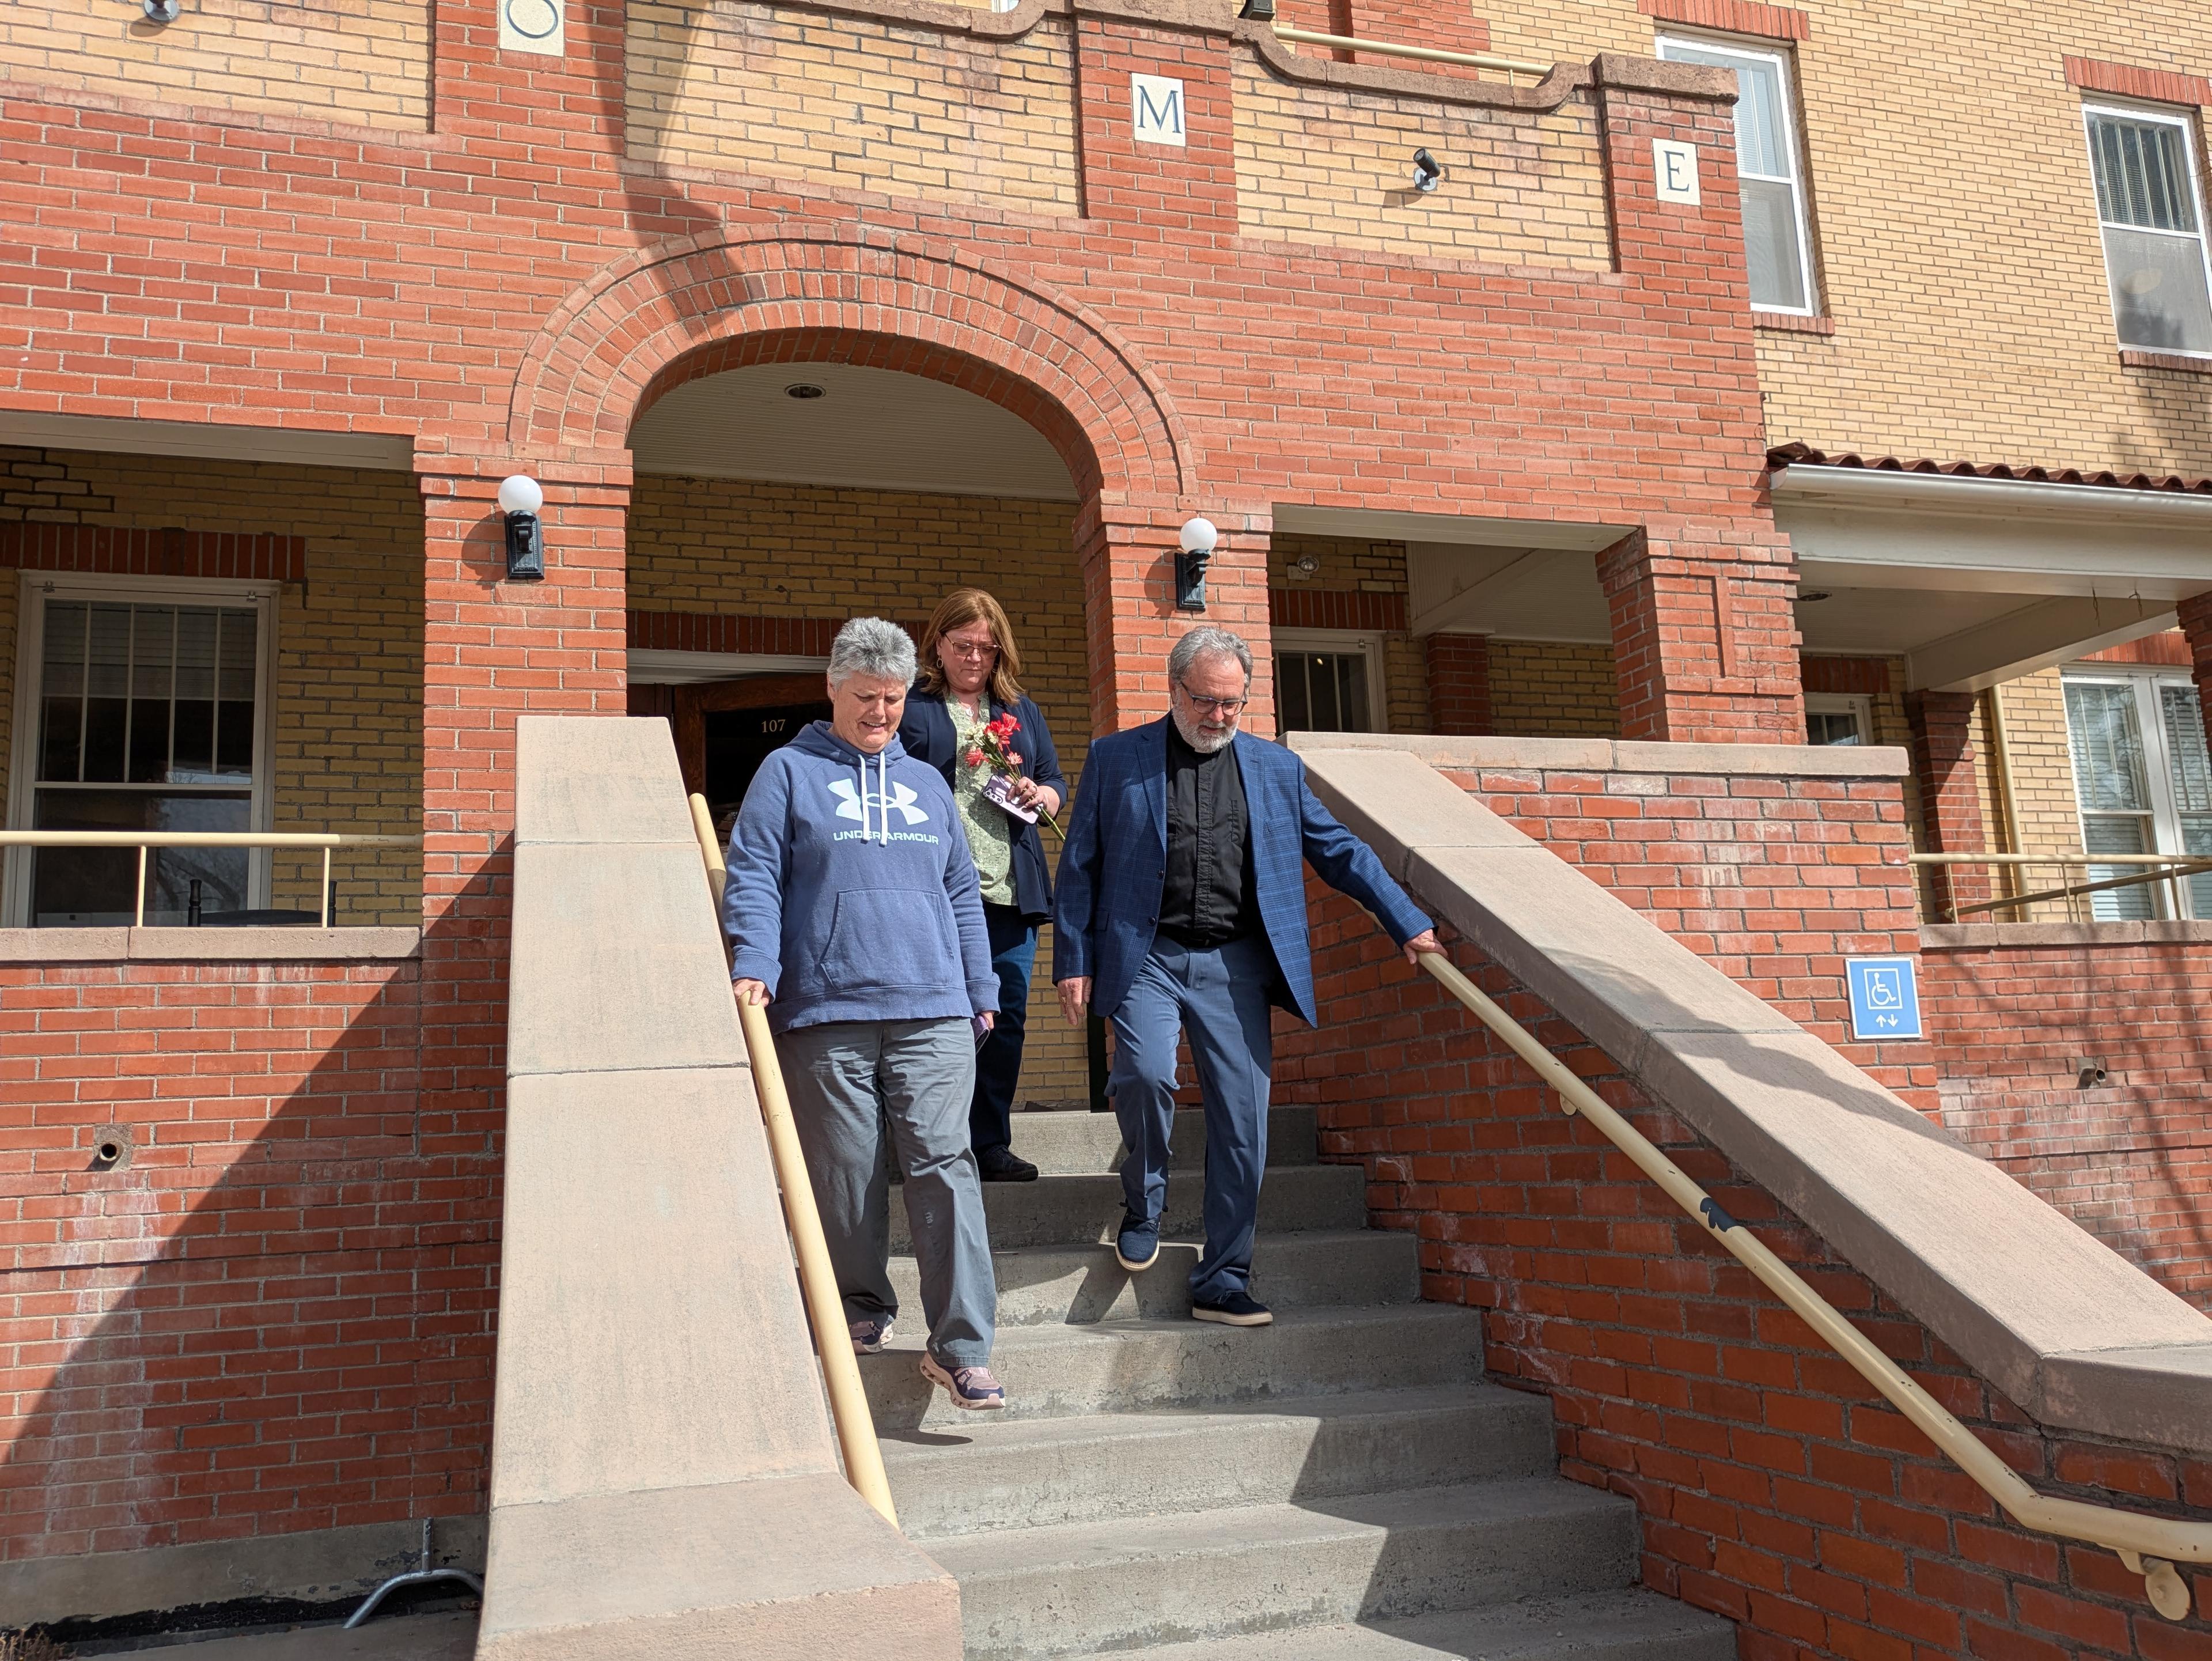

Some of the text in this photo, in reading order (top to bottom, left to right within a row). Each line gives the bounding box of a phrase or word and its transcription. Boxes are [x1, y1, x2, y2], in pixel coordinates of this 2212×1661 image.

[506, 0, 1690, 192] O M E
[761, 718, 786, 733] 107
